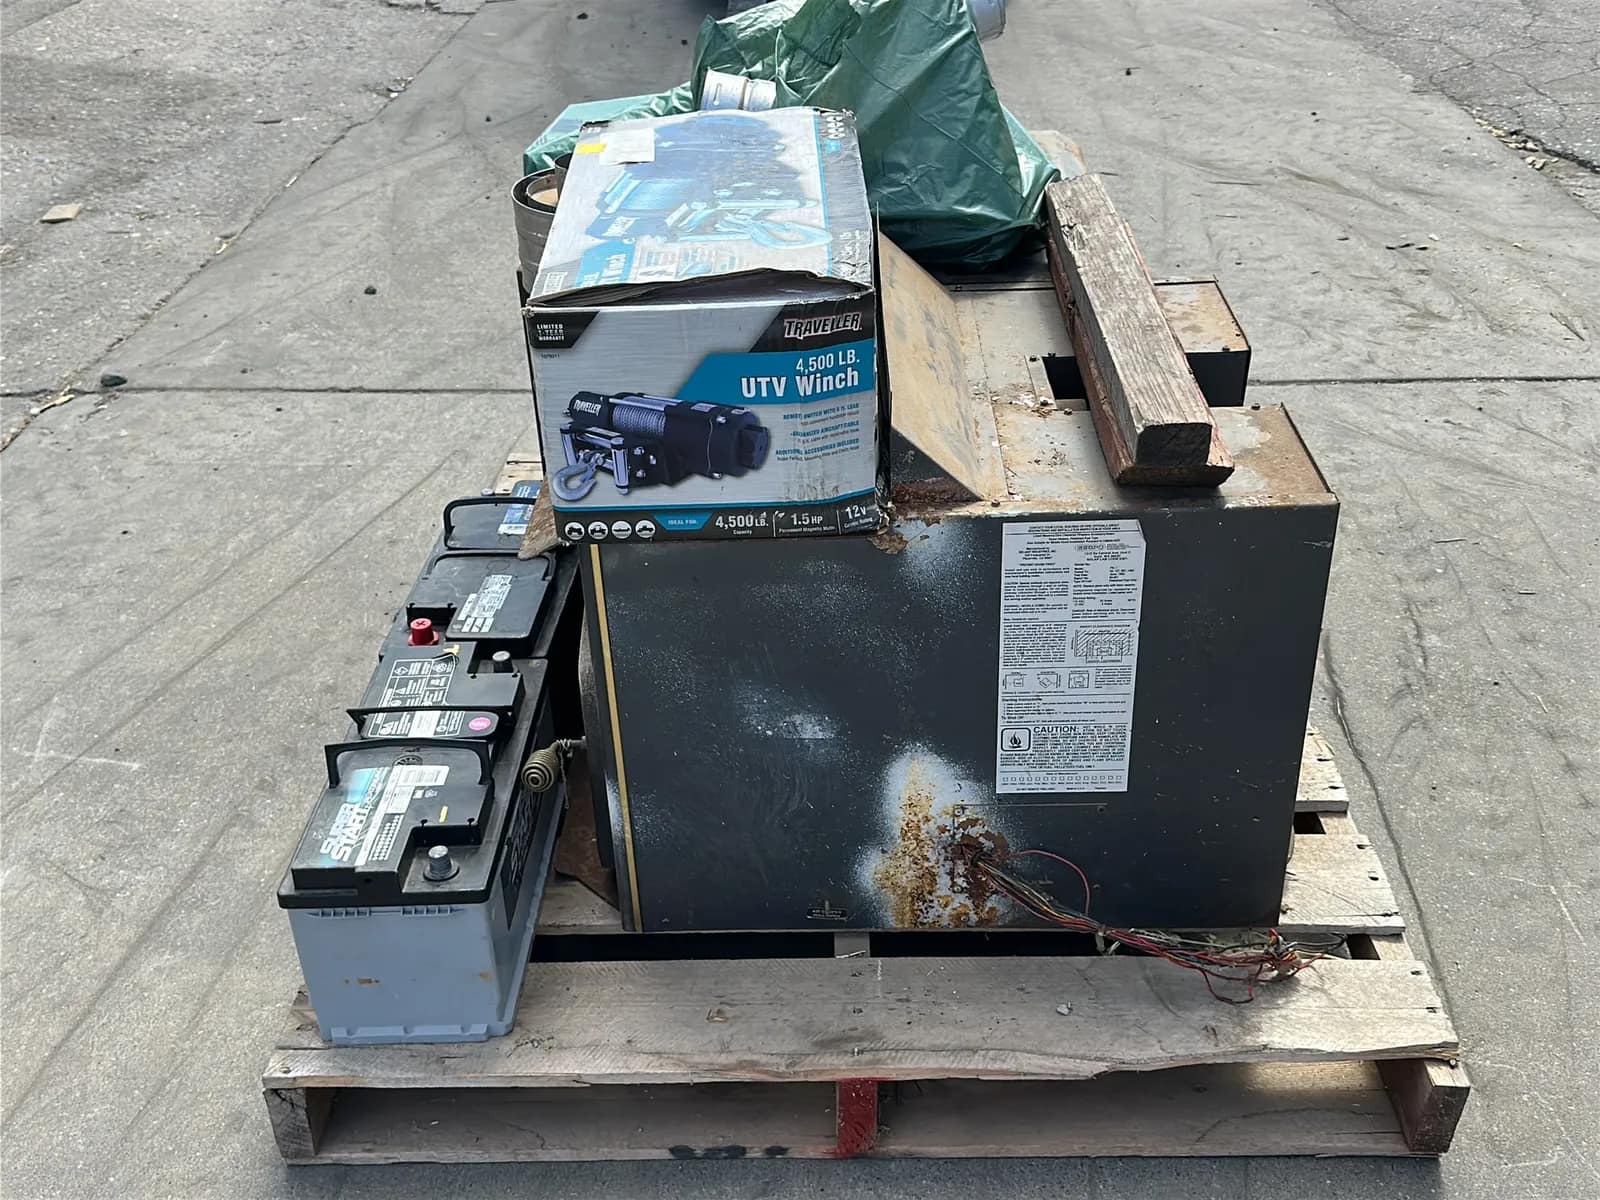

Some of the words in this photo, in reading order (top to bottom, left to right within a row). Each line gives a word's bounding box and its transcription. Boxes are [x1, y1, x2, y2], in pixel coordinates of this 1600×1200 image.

[784, 312, 862, 340] TRAVELLER
[796, 353, 834, 374] 4,500
[838, 349, 860, 366] LB.
[741, 376, 787, 398] UTV
[795, 366, 859, 397] Winch
[573, 399, 602, 416] TRAVELLER
[715, 514, 754, 530] 4,500
[754, 518, 769, 527] LB.
[791, 512, 810, 525] 1.5
[811, 515, 823, 524] HP
[1033, 725, 1080, 734] CAUTION:
[320, 803, 361, 854] SUPER
[329, 806, 370, 862] START
